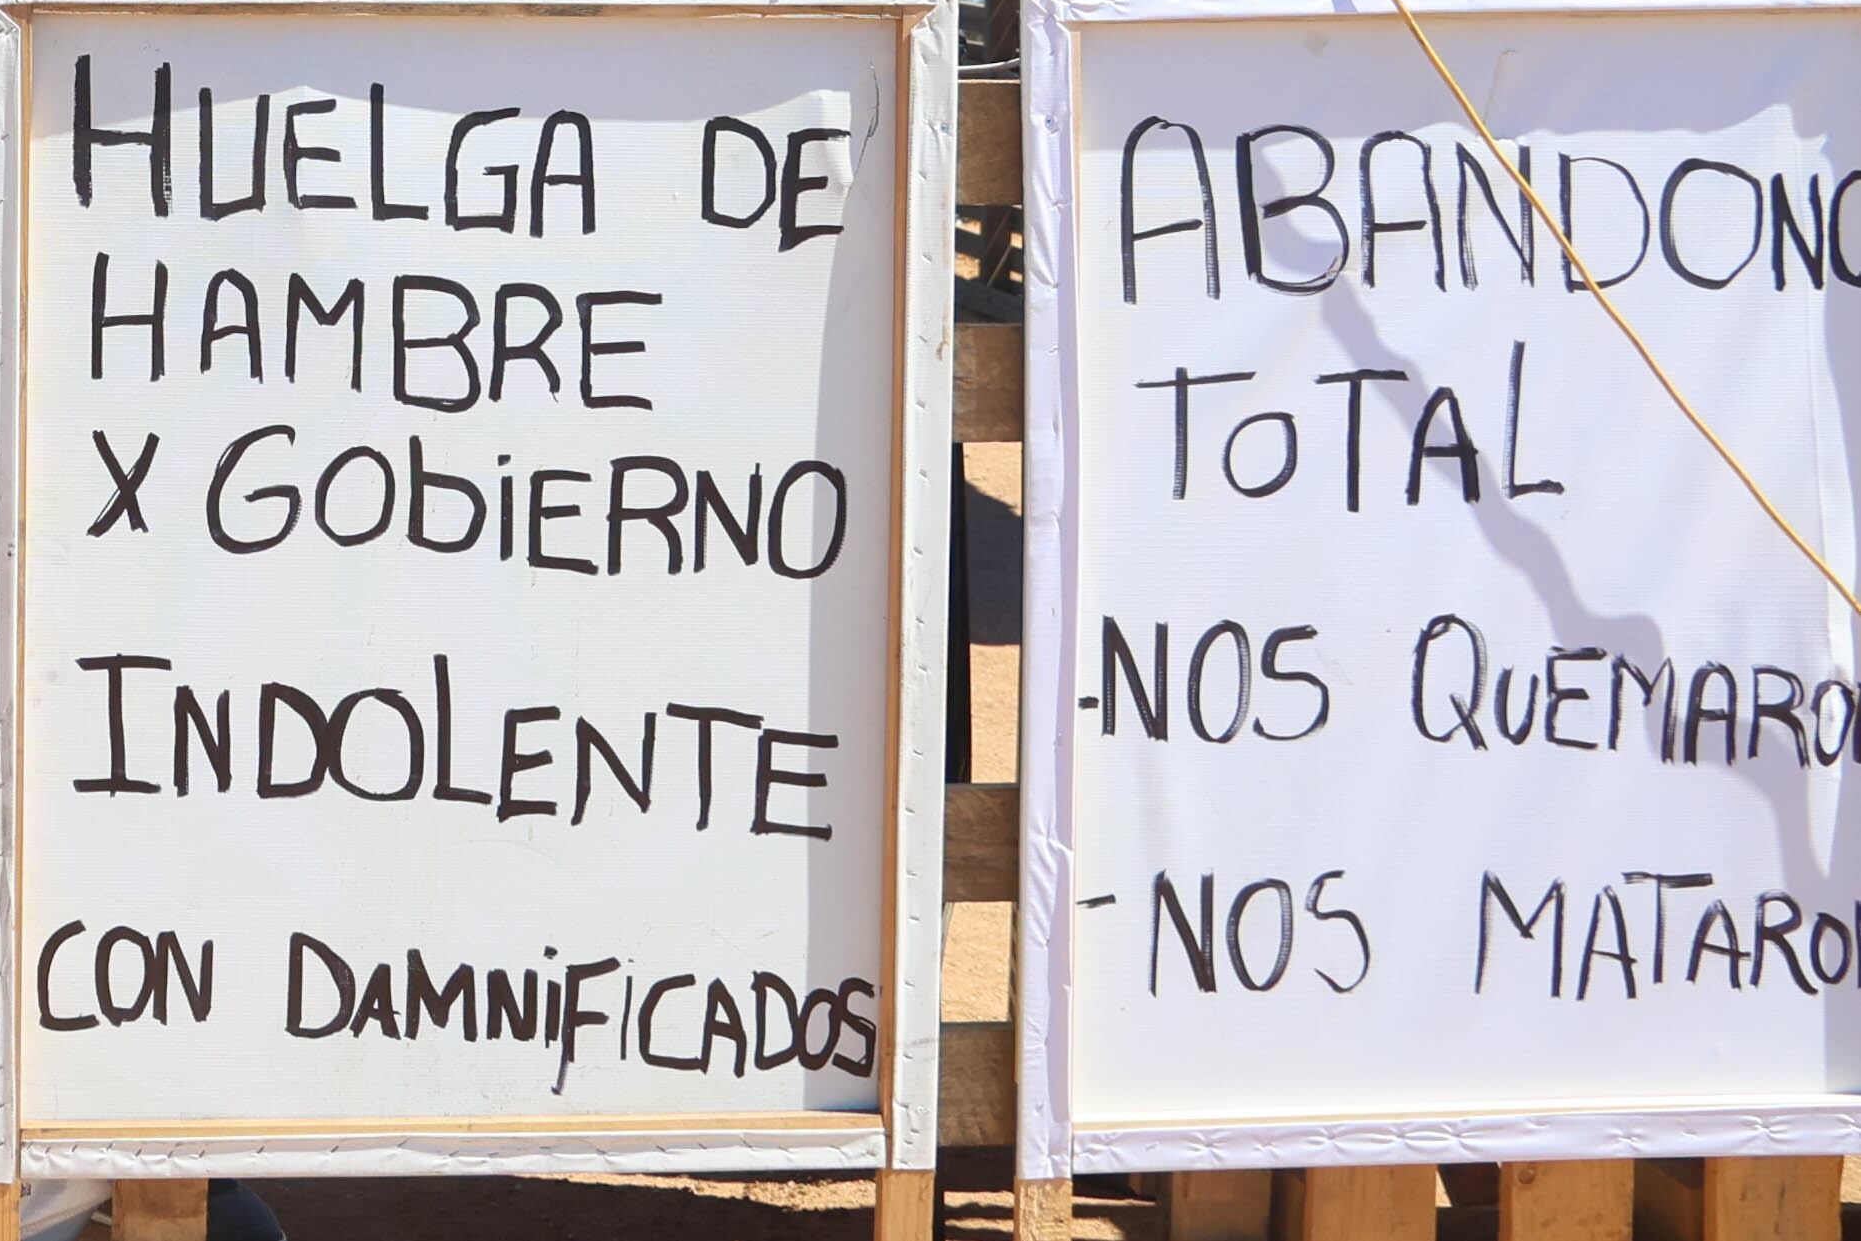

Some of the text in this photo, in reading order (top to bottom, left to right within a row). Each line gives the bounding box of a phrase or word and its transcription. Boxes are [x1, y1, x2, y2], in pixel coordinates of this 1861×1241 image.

[72, 53, 853, 253] HUELGA DE
[90, 251, 663, 413] HAMBRE
[86, 429, 161, 539] X
[72, 652, 840, 842] INDOLENTE
[1412, 614, 1861, 768] QUEMARO
[36, 919, 215, 1033] CON
[1478, 871, 1861, 1000] MATARO
